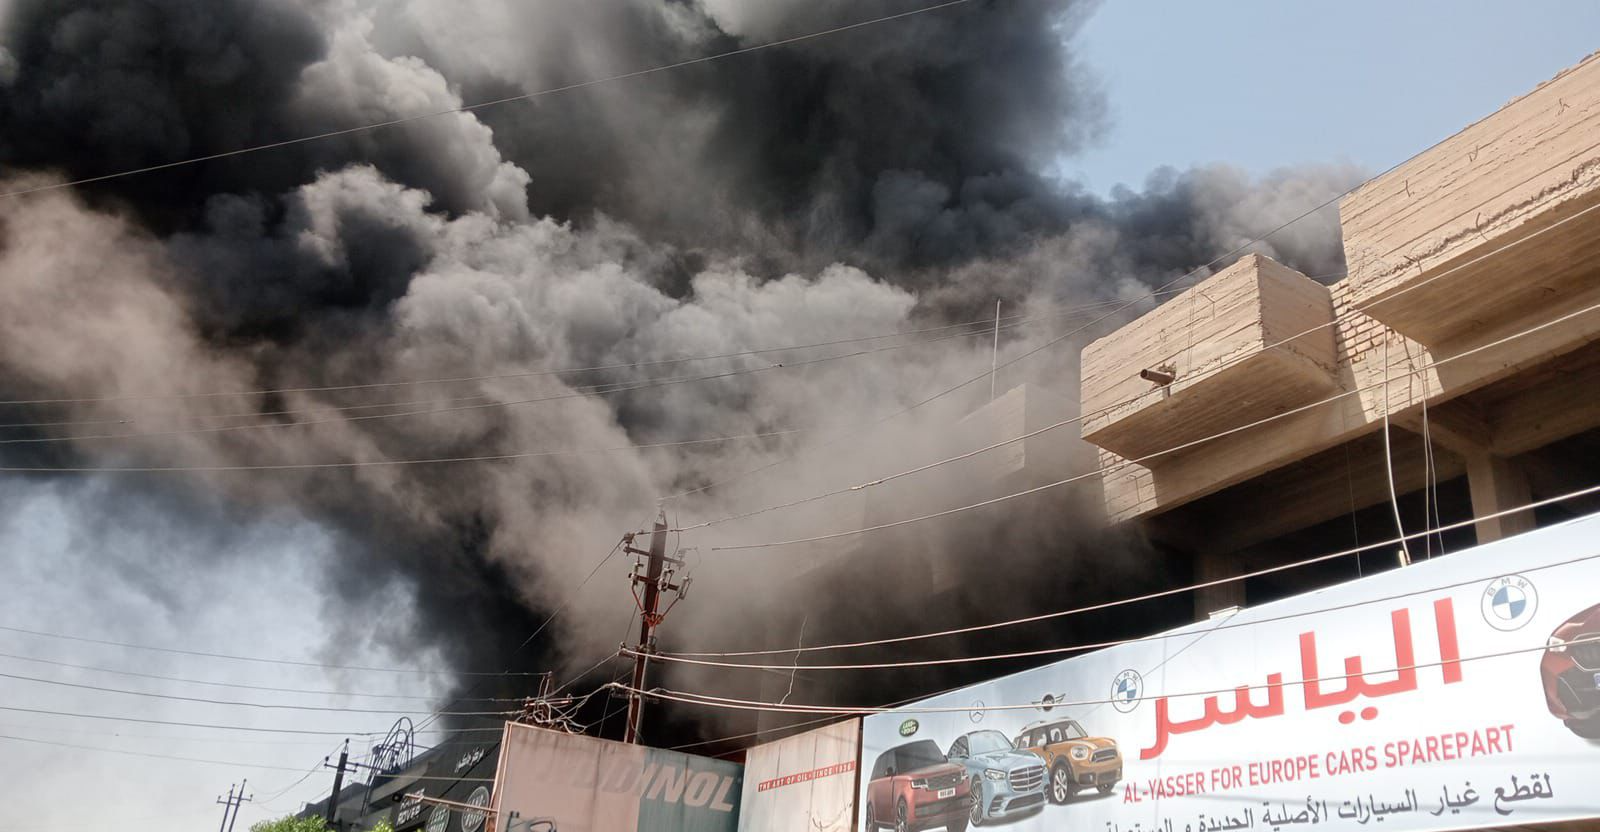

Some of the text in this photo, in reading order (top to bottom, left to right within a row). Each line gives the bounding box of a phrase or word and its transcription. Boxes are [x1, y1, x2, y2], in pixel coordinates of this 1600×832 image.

[1487, 577, 1528, 597] BMW
[1140, 597, 1463, 760] الياسر
[1123, 724, 1515, 805] AL-YASSER FOR EUROPE CARS SPAREPART
[1338, 788, 1419, 824] السيارات
[1430, 781, 1480, 816] غيار
[1494, 772, 1554, 815] لقطع
[1262, 794, 1328, 832] الأصلية
